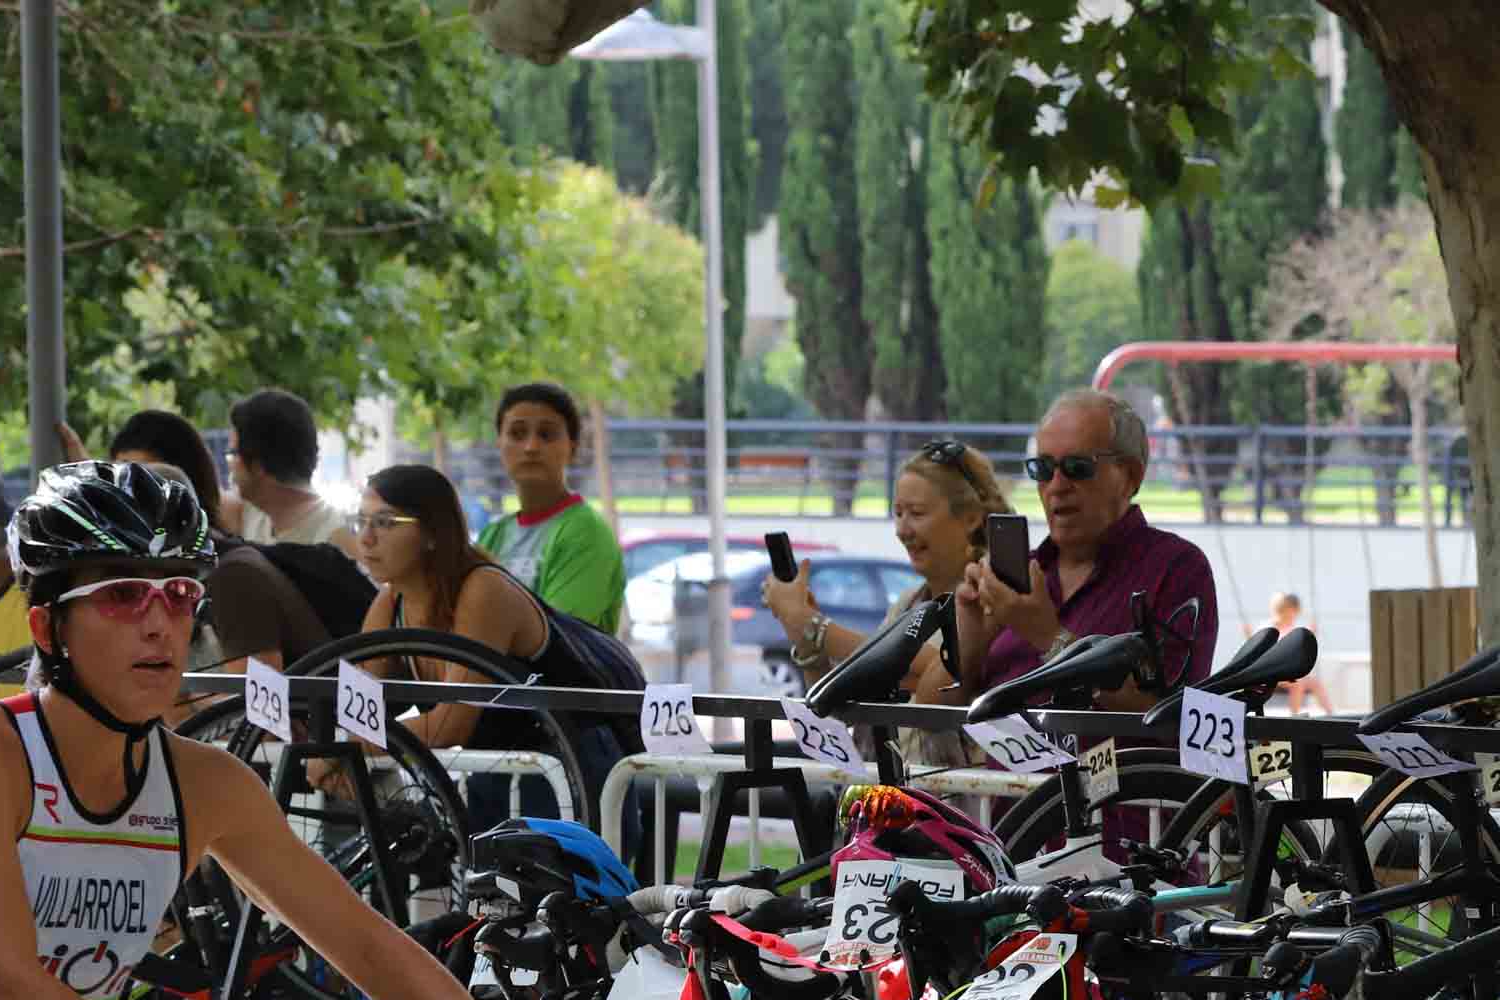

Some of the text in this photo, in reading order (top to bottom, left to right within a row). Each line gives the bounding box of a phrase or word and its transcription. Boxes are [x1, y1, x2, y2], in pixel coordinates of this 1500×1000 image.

[250, 679, 282, 723] 229
[344, 685, 380, 731] 228
[650, 701, 693, 736] 226
[792, 717, 850, 763] 225
[990, 733, 1056, 764] 224
[1187, 708, 1236, 758] 223
[1089, 748, 1112, 776] 224
[1257, 750, 1292, 774] 22
[1380, 747, 1454, 769] 222
[35, 874, 147, 933] VILLARROEL
